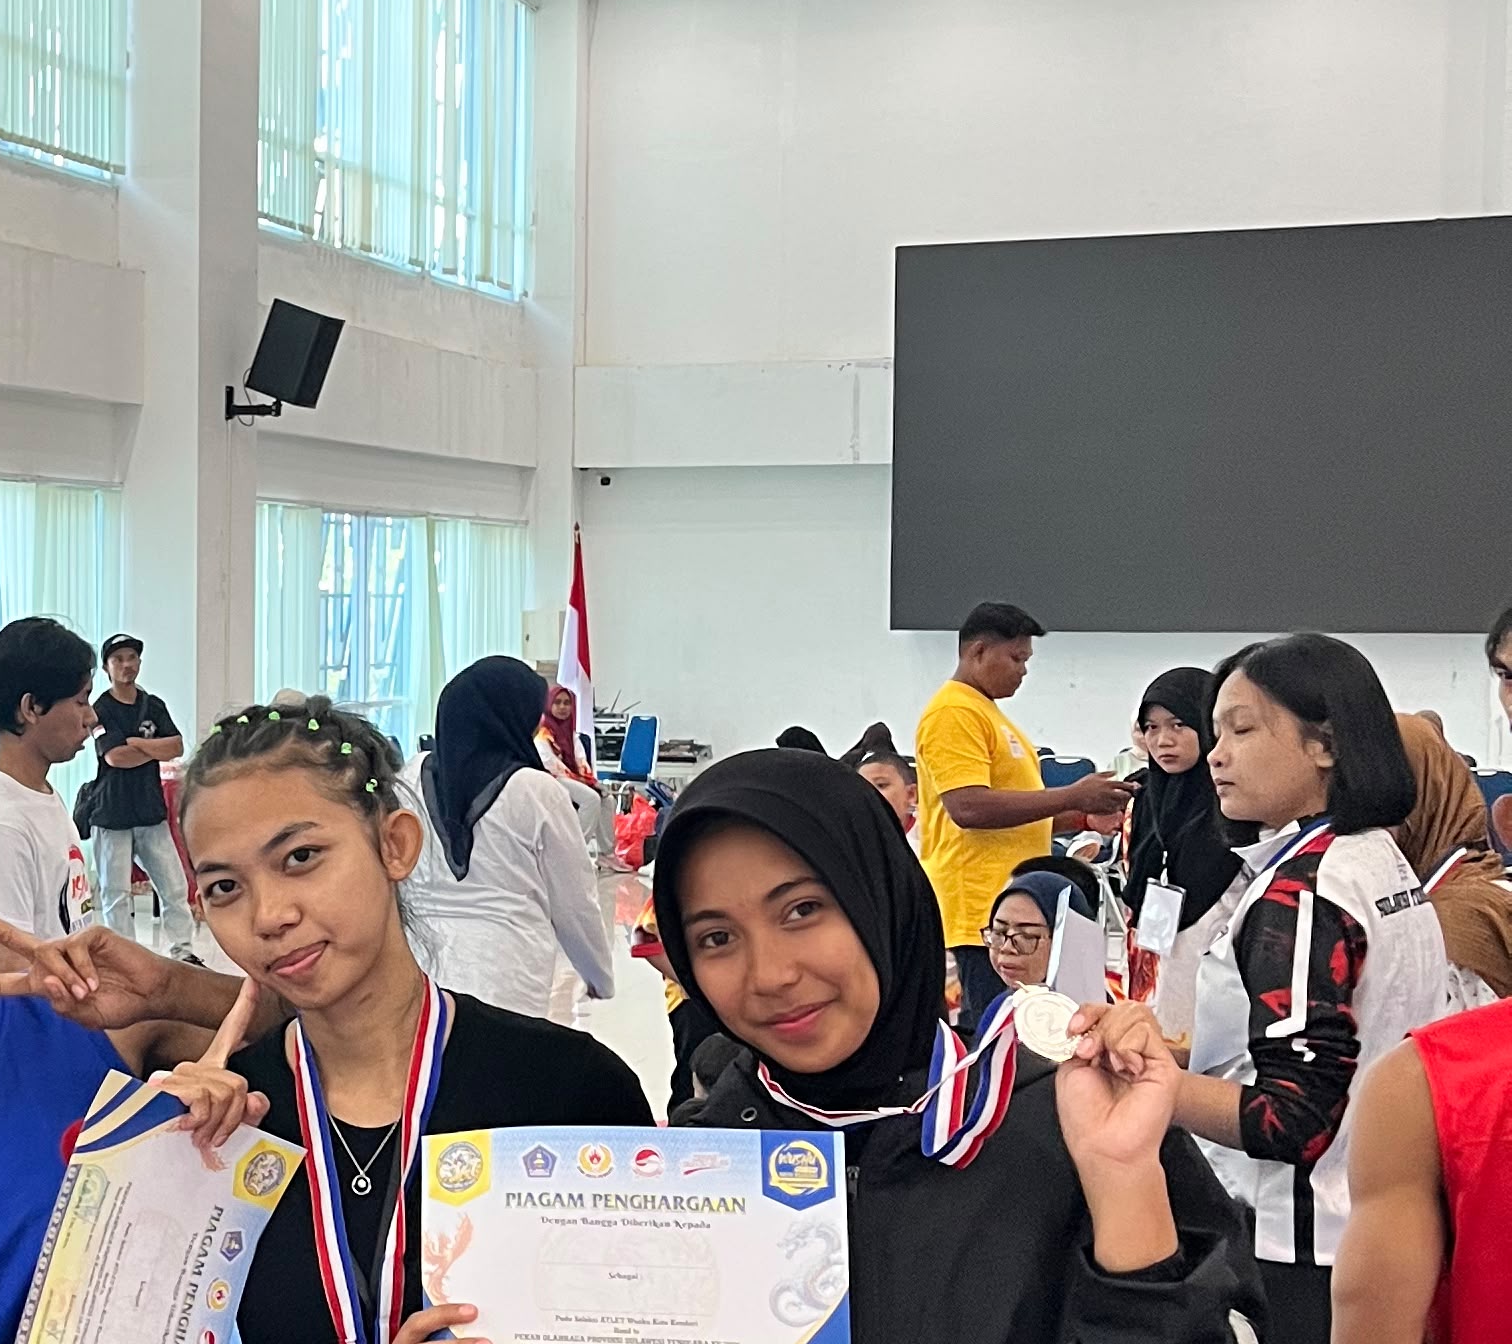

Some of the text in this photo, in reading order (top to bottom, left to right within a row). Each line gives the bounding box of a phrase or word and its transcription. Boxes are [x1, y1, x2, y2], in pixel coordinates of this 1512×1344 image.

[505, 1192, 746, 1213] PIAGAM PENGHARGAAN
[541, 1216, 711, 1229] Dengan Bangga Diberikan Kepada
[190, 1204, 224, 1277] PIAGAM
